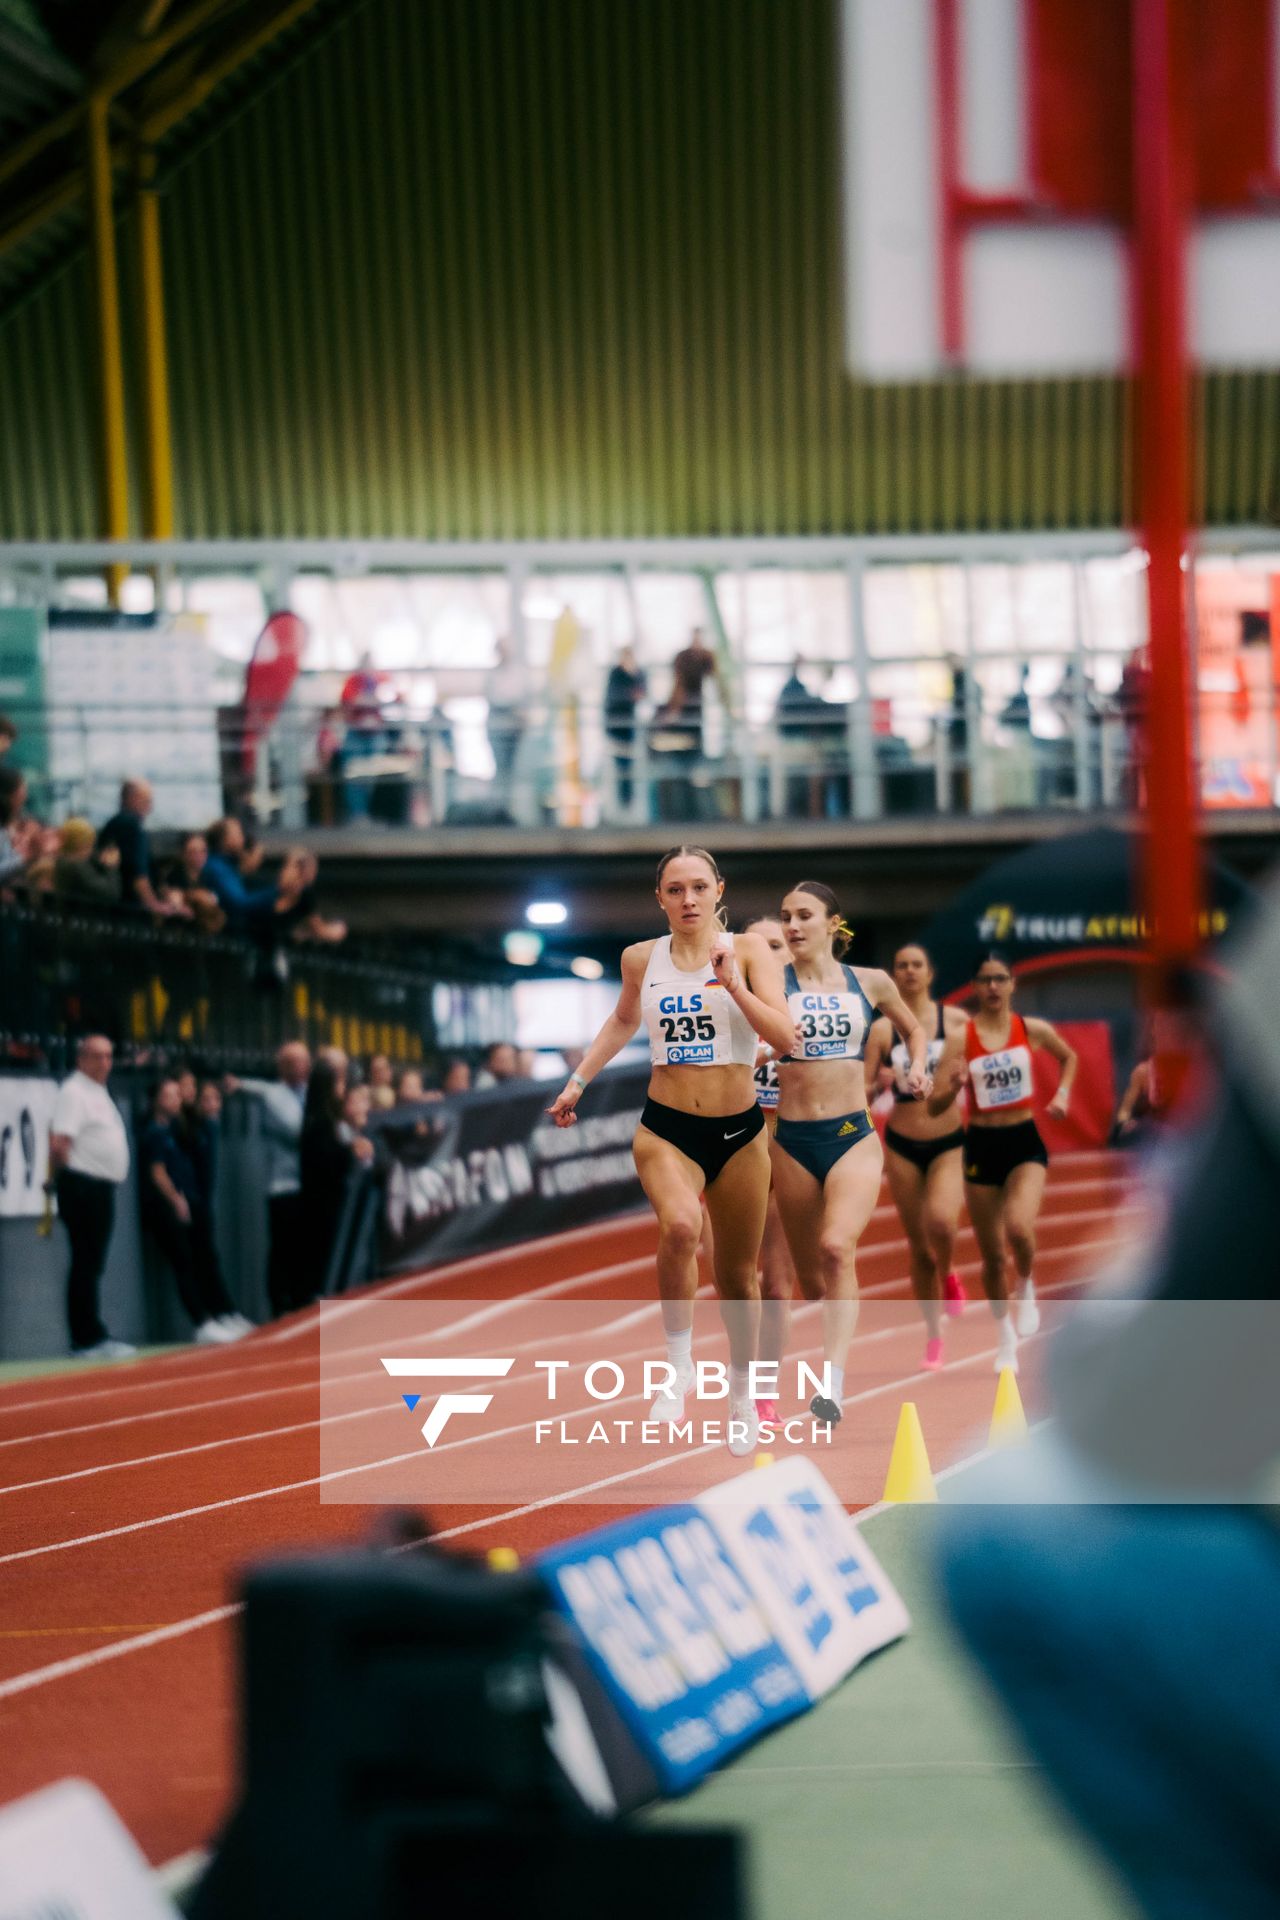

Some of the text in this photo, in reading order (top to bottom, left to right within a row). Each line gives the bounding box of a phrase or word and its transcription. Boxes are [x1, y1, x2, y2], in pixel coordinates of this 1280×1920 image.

[659, 994, 703, 1014] GLS
[802, 996, 840, 1010] GLS
[659, 1015, 716, 1043] 235
[801, 1014, 851, 1038] 335
[683, 1047, 712, 1057] PLAN
[983, 1066, 1022, 1090] 299
